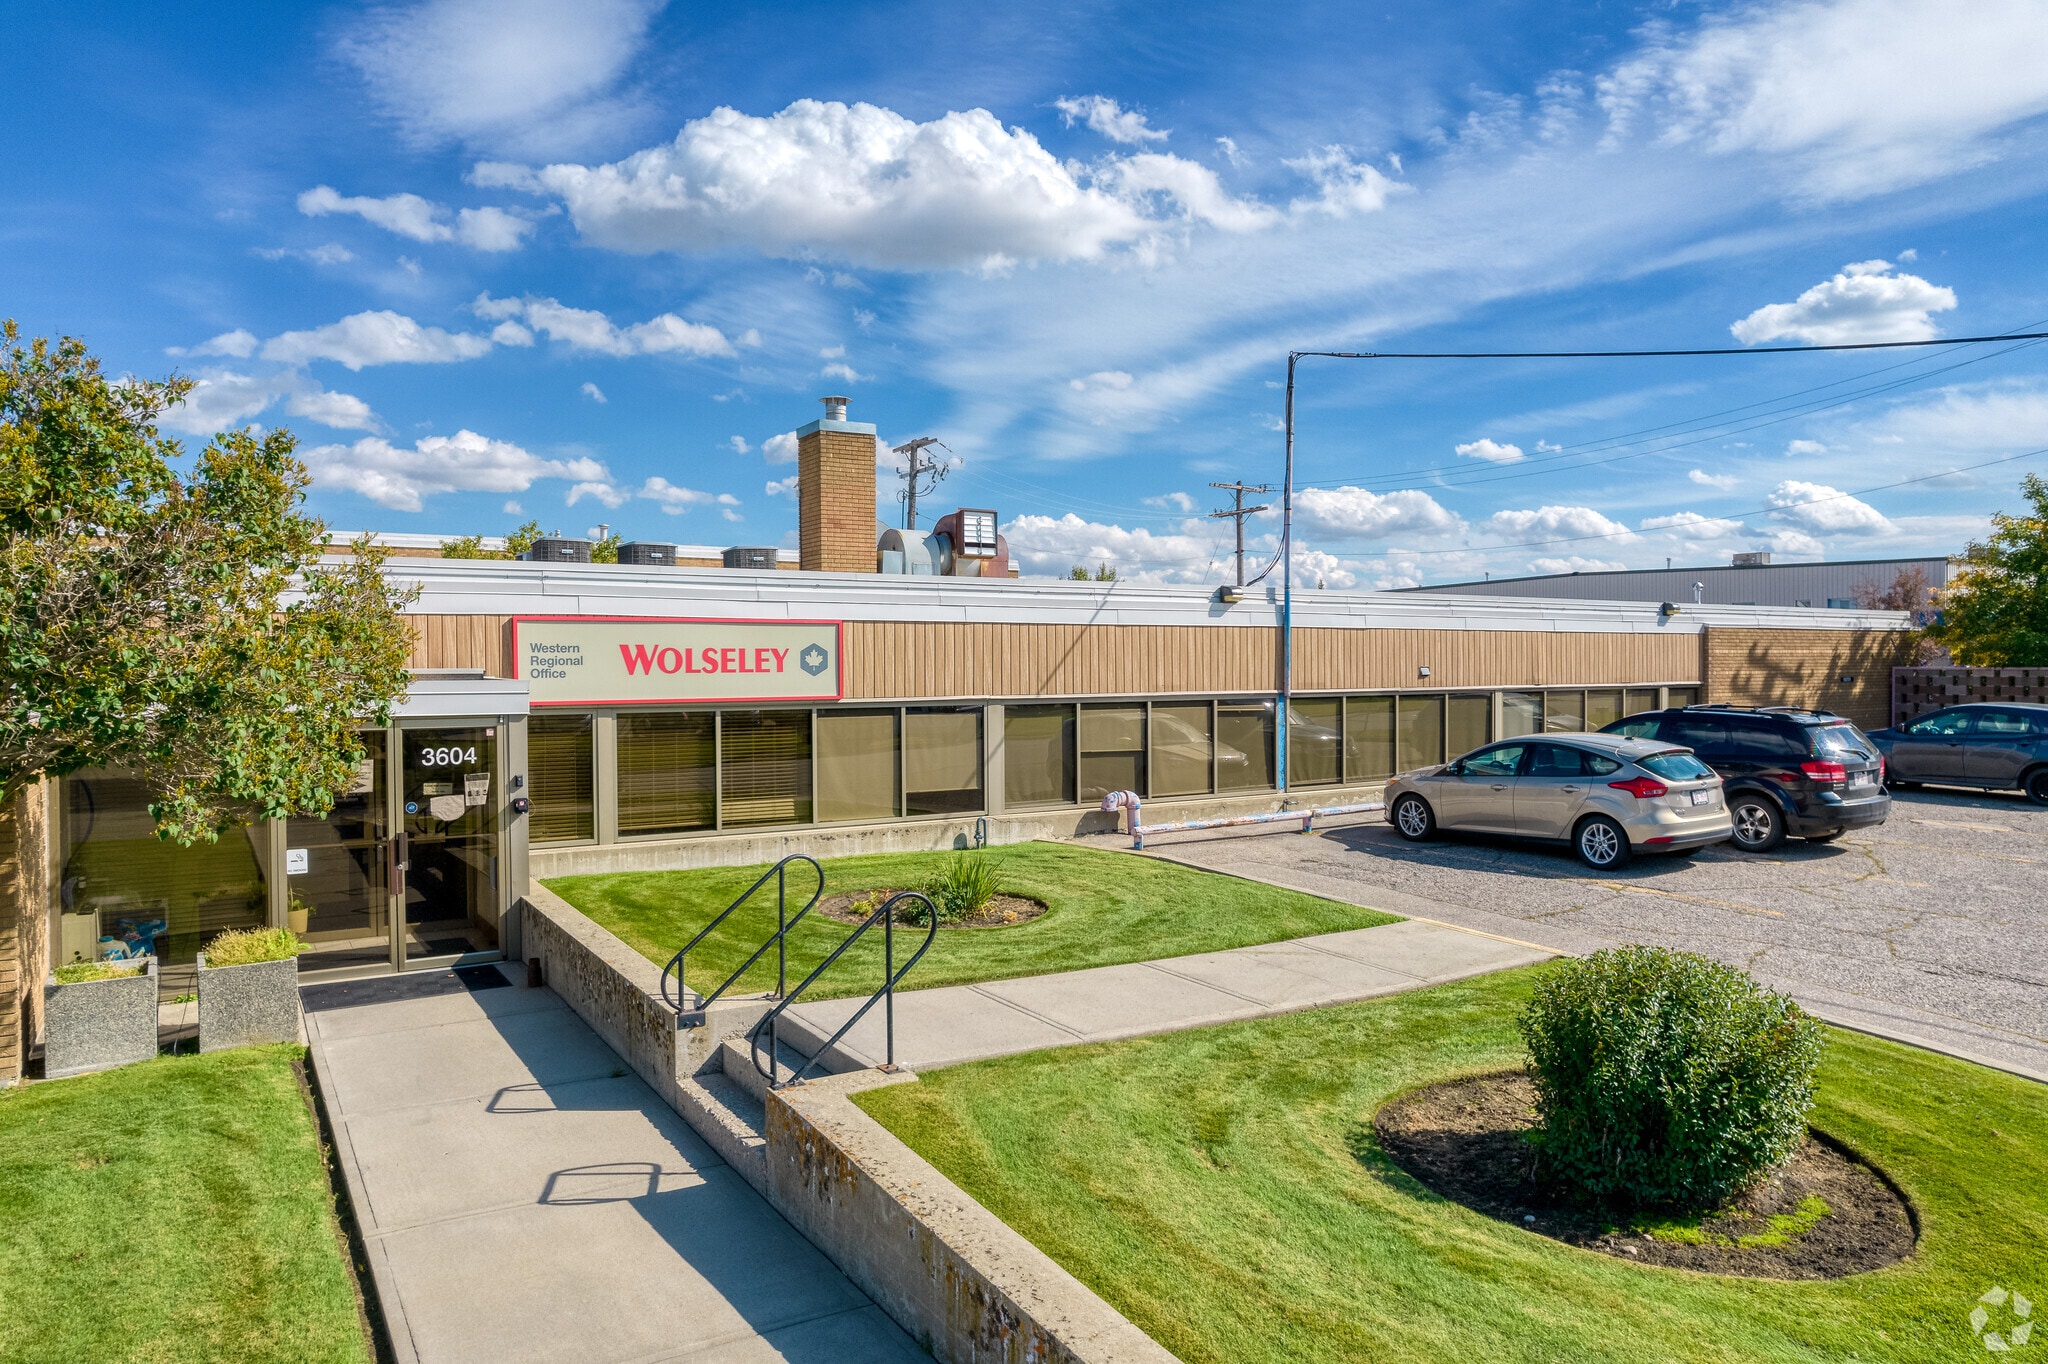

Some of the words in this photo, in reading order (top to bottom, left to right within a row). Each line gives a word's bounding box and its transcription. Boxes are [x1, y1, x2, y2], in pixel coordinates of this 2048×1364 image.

[529, 642, 580, 653] Western
[530, 655, 584, 668] Regional
[618, 643, 790, 676] WOLSELEY
[530, 668, 567, 679] Office
[421, 746, 478, 767] 3604
